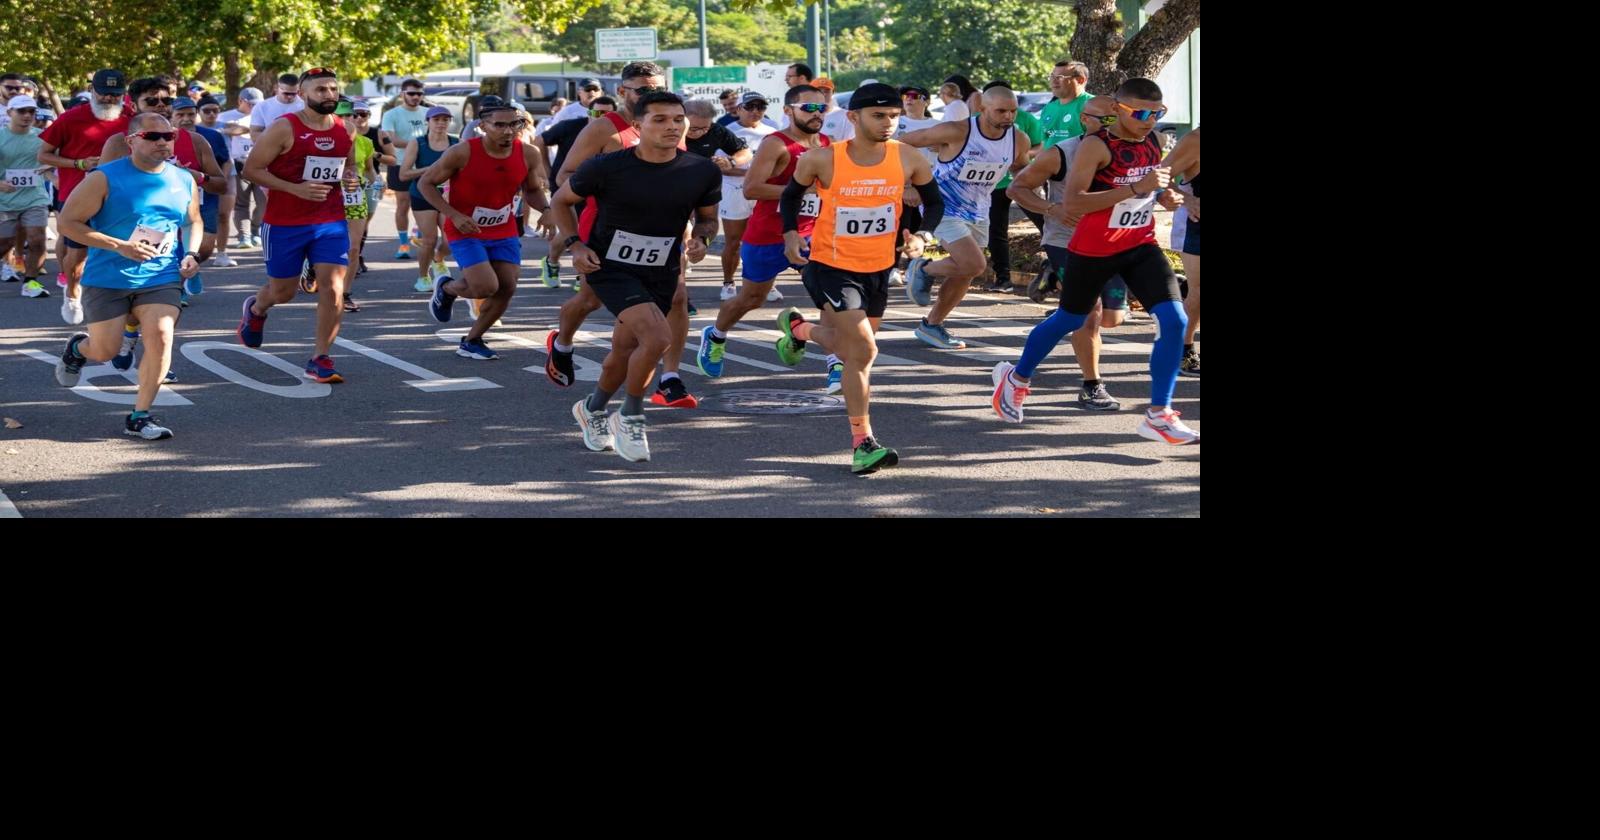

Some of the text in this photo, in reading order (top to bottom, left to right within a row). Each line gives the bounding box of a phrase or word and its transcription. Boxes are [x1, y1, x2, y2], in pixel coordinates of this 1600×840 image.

[311, 166, 339, 180] 034
[966, 169, 996, 181] 010
[1112, 174, 1144, 184] RUNNE
[11, 176, 33, 186] 031
[839, 185, 898, 196] PUERTO RICO
[345, 193, 358, 204] 51
[800, 199, 815, 214] 25
[477, 214, 505, 226] 006
[1119, 209, 1149, 226] 026
[846, 217, 887, 235] 073
[617, 244, 660, 264] 015
